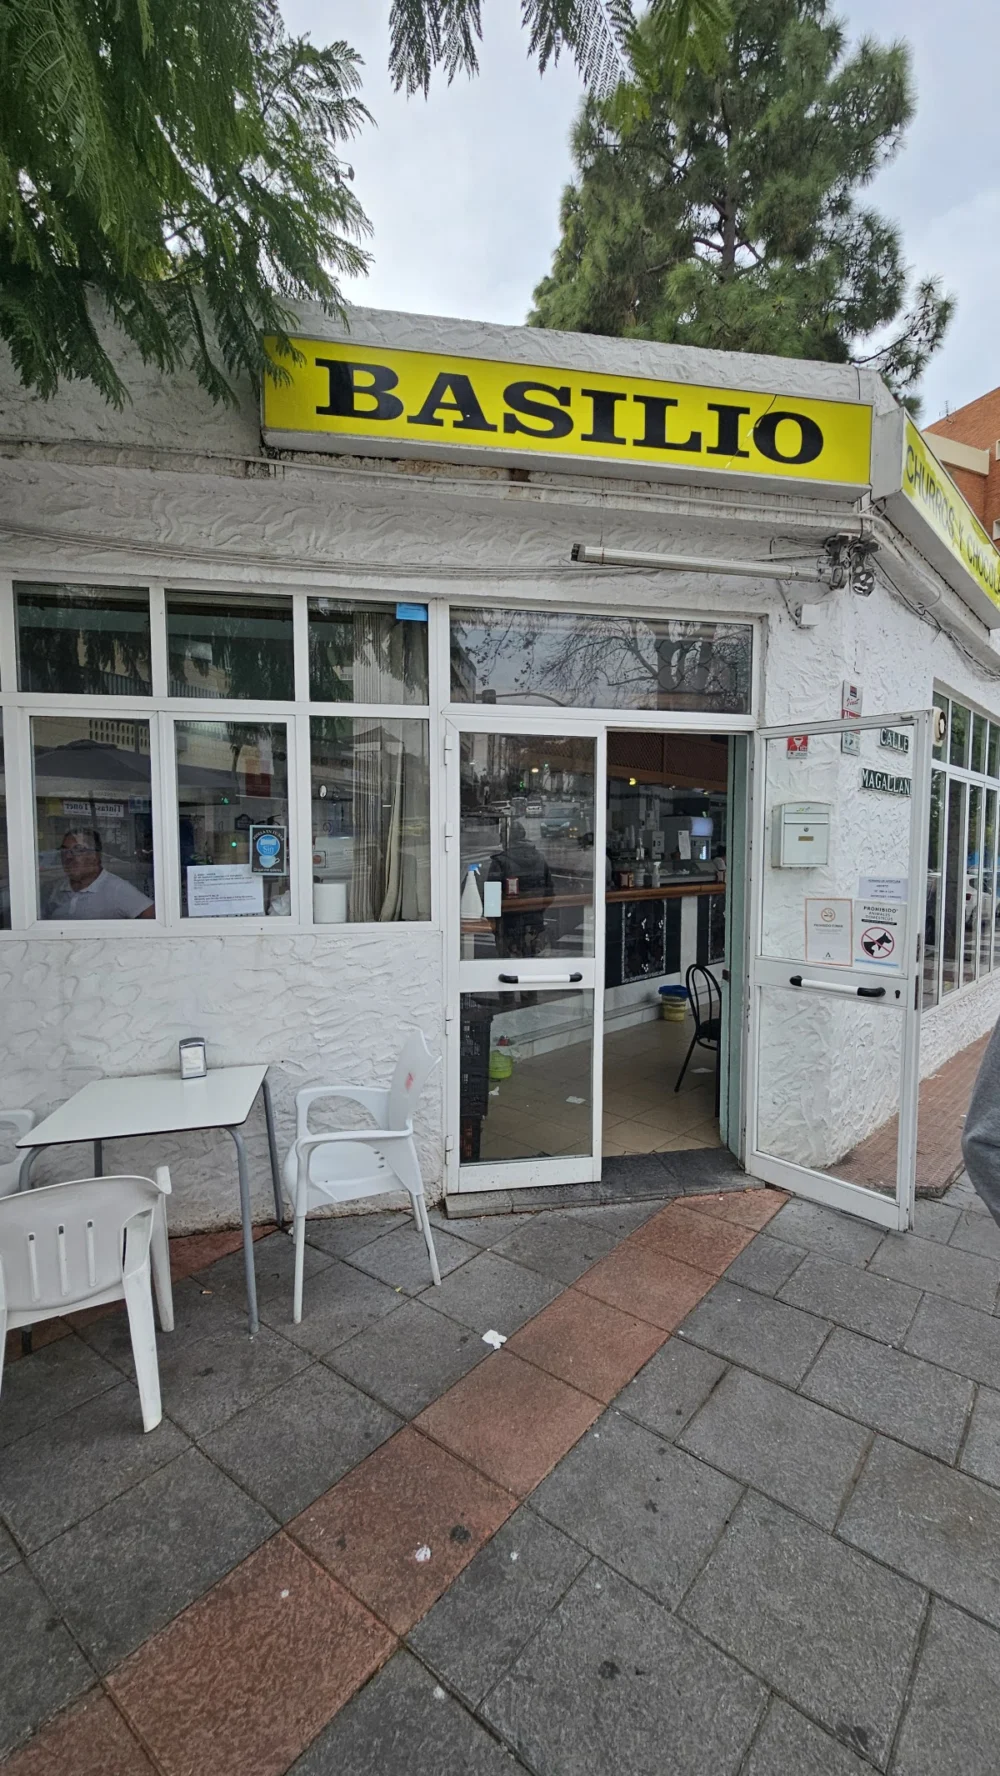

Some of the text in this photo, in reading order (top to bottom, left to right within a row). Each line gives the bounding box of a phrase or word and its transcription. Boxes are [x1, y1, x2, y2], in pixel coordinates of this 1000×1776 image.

[315, 357, 824, 465] BASILIO
[906, 444, 1000, 595] CHURROS Y CHOCOL
[881, 728, 908, 752] CALLE
[263, 845, 274, 853] Sin
[863, 906, 897, 914] PROHIBIDO
